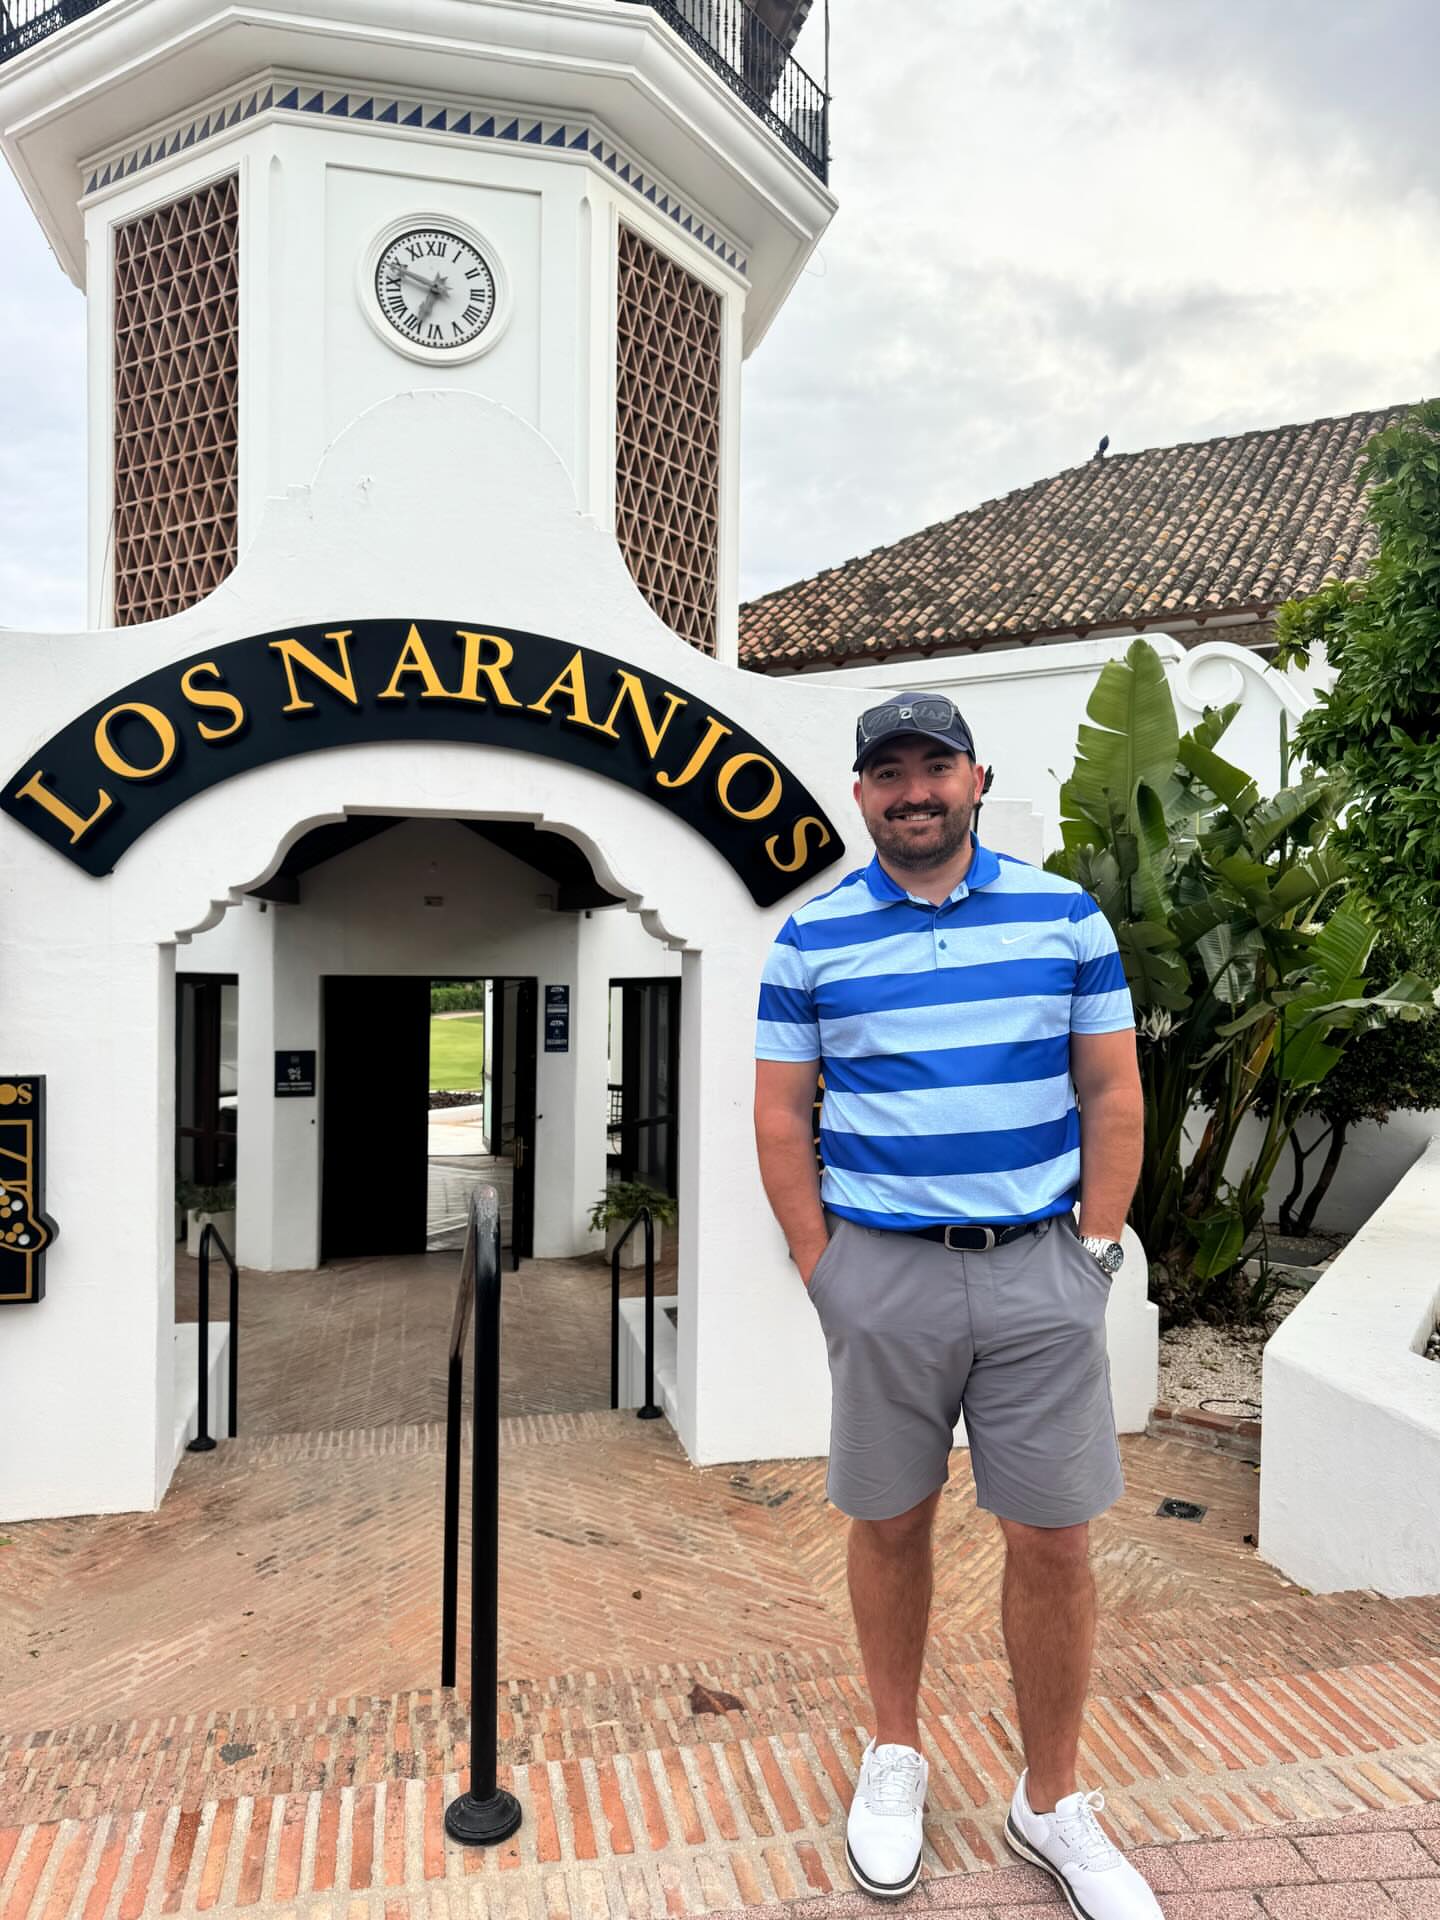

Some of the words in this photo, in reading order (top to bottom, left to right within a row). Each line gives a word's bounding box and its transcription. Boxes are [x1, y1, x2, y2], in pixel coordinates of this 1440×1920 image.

[406, 242, 424, 261] XI
[426, 241, 447, 257] XII
[452, 250, 462, 263] I
[464, 267, 481, 280] II
[470, 289, 486, 303] III
[462, 305, 483, 326] IIII
[427, 323, 444, 340] VI
[451, 321, 464, 337] V
[14, 662, 246, 845] LOS
[268, 623, 832, 873] NARANJOS
